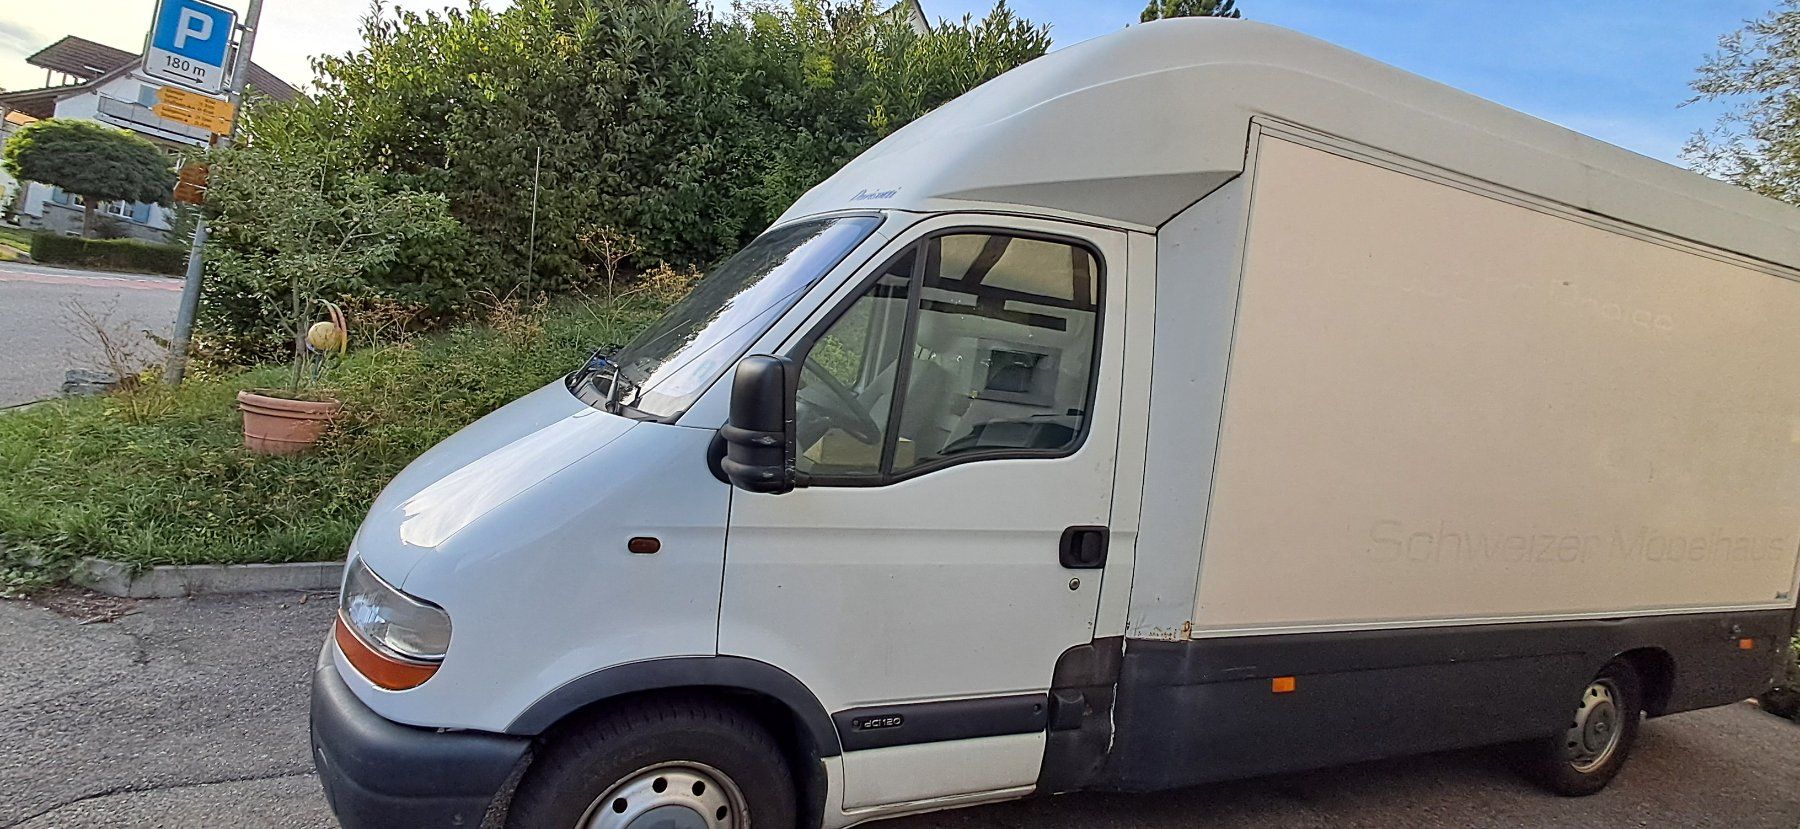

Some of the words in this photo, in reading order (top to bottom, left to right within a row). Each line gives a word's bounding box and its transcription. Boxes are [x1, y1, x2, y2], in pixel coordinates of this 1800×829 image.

[173, 6, 214, 49] P
[166, 55, 191, 72] 180
[193, 65, 206, 77] m
[1366, 518, 1601, 564] Schweizer
